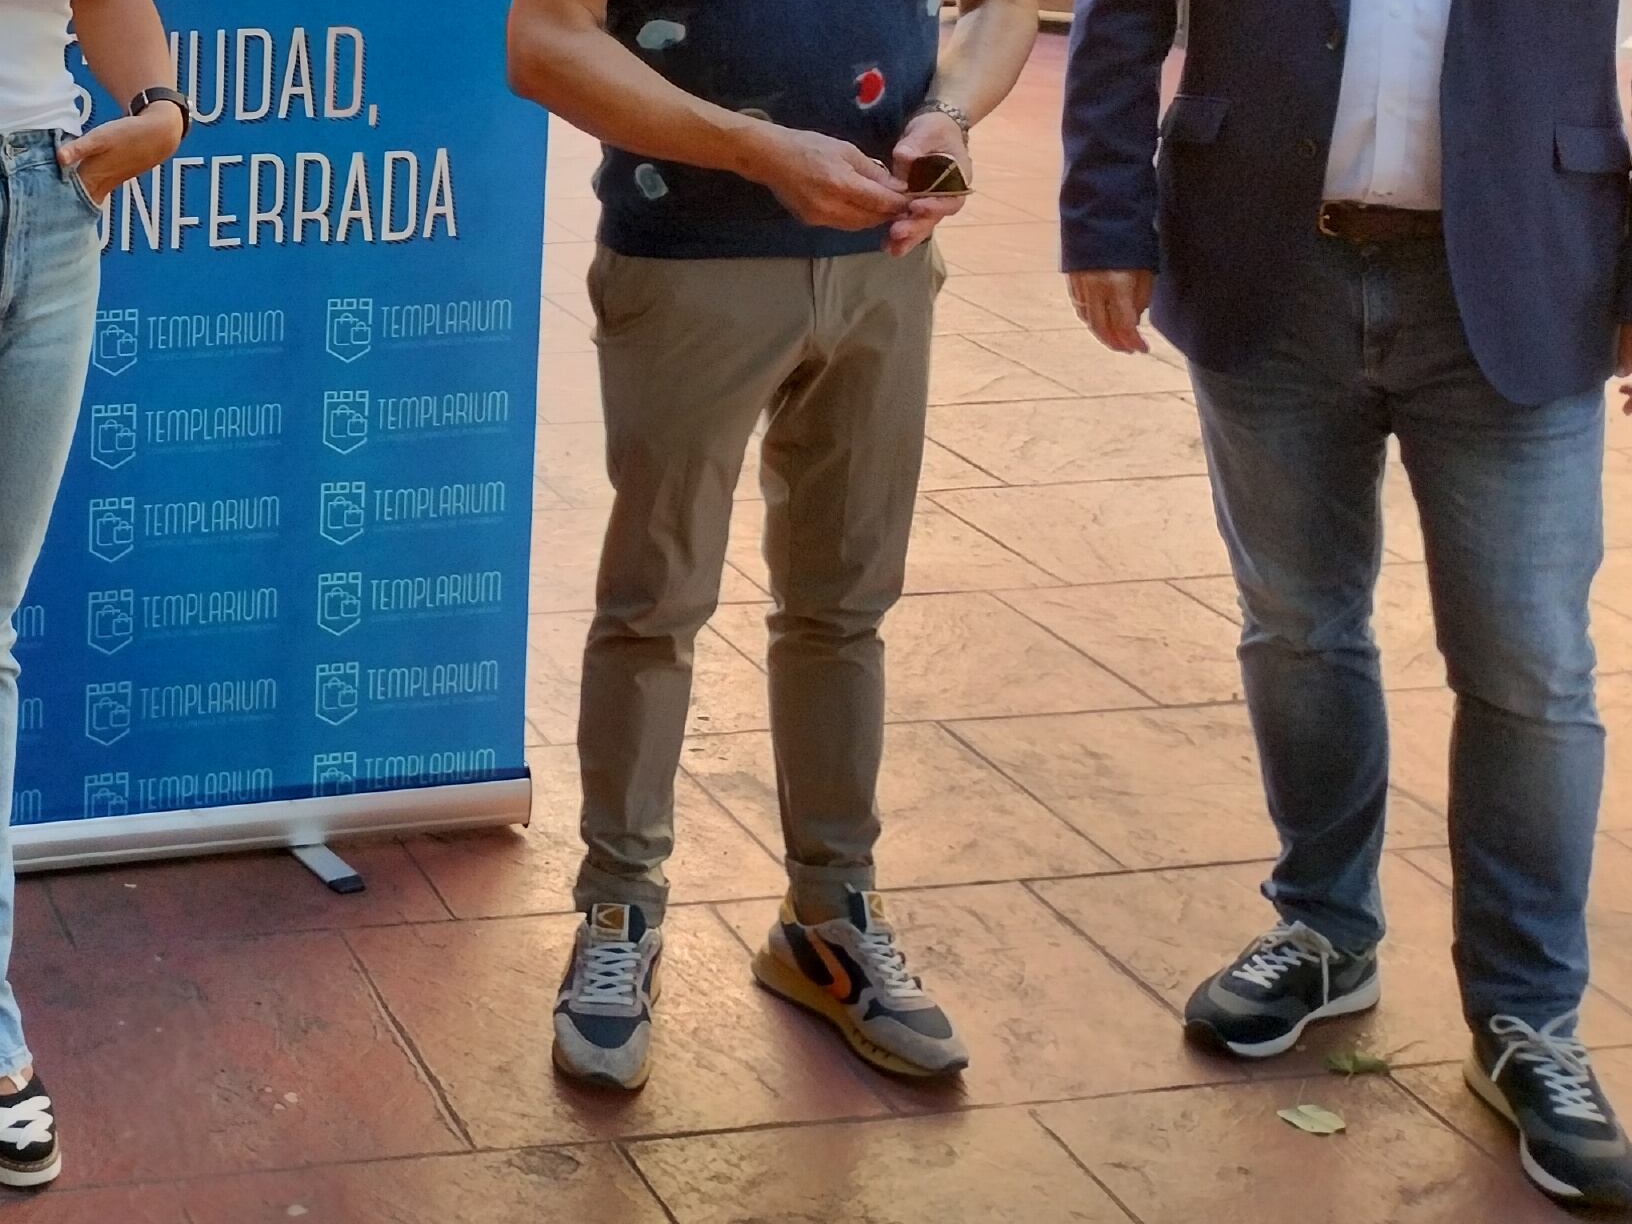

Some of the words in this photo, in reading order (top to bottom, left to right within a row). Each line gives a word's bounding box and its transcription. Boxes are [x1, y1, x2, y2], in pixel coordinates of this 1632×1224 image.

[147, 310, 285, 350] TEMPLARIUM
[381, 299, 511, 338] TEMPLARIUM
[145, 404, 281, 443] TEMPLARIUM
[377, 391, 508, 430] TEMPLARIUM
[144, 496, 279, 536] TEMPLARIUM
[374, 481, 505, 520] TEMPLARIUM
[141, 587, 277, 628] TEMPLARIUM
[370, 572, 501, 610] TEMPLARIUM
[139, 678, 276, 719] TEMPLARIUM
[367, 661, 497, 700] TEMPLARIUM
